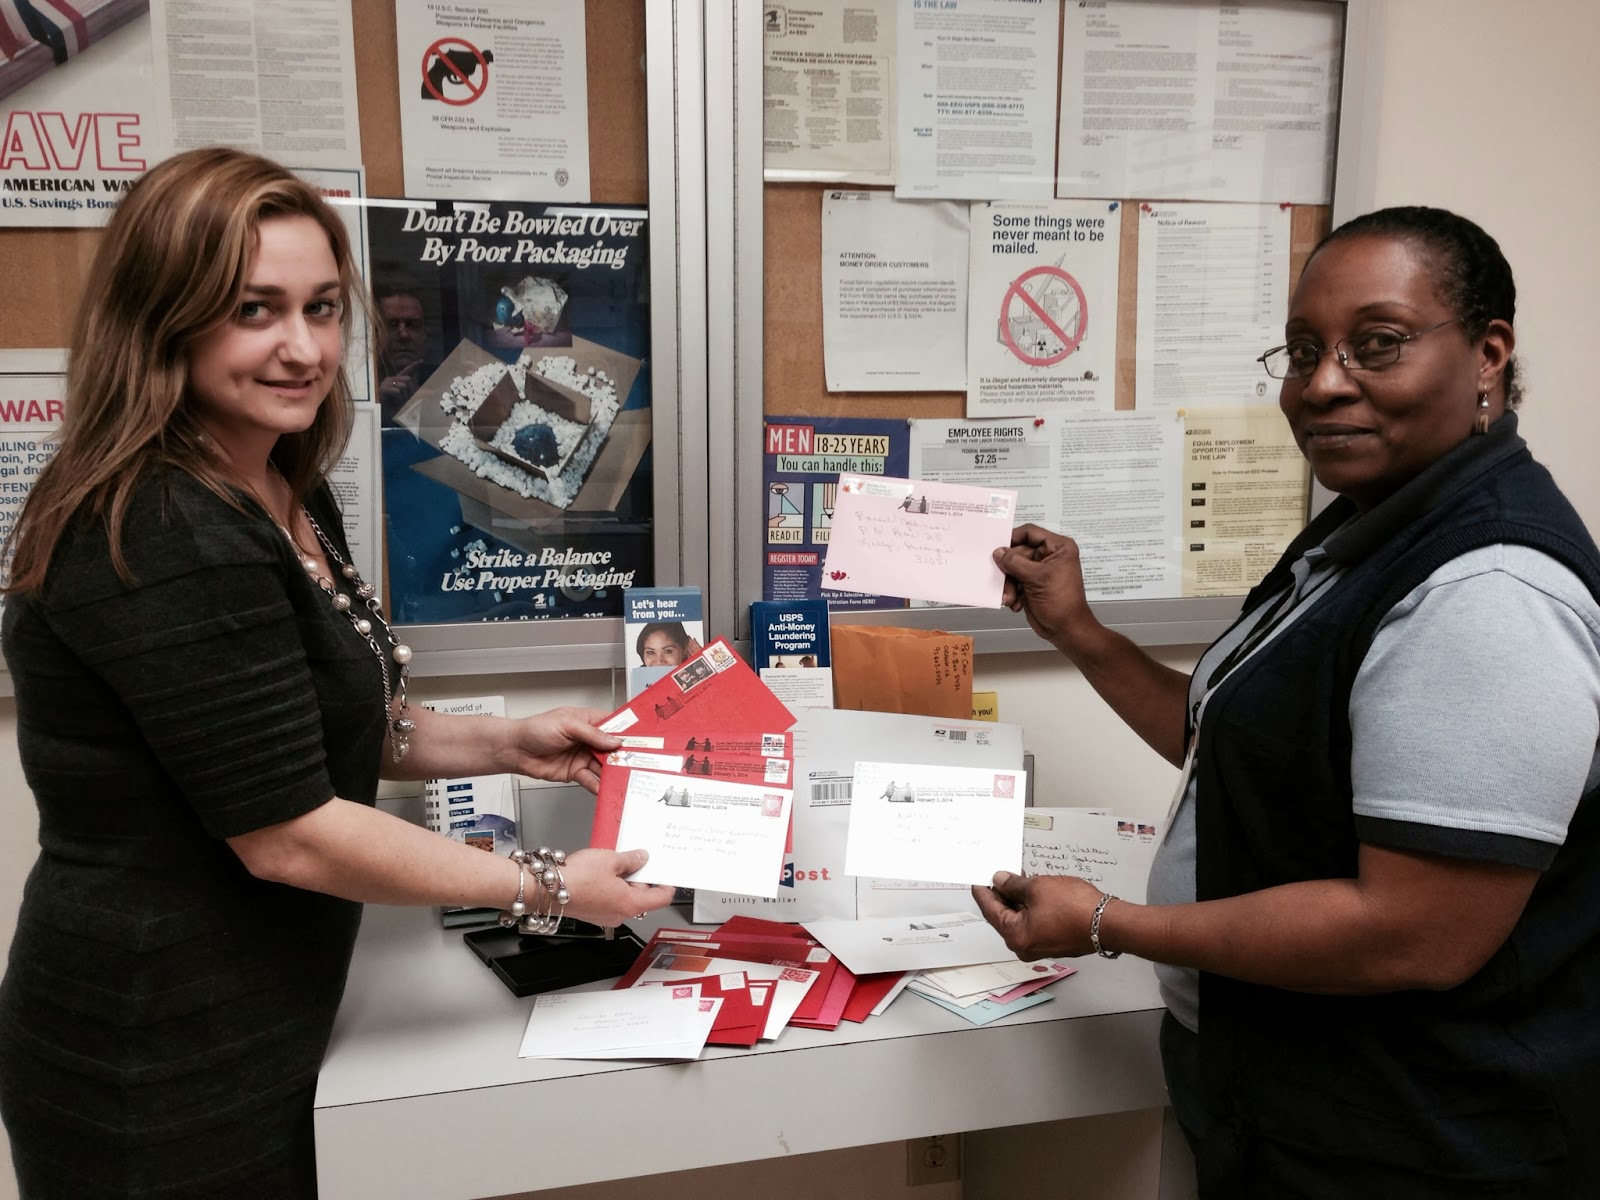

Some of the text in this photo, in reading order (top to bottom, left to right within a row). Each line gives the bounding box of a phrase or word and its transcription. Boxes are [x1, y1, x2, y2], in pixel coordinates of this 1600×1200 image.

[455, 6, 476, 14] Section
[923, 1, 938, 9] THE
[940, 2, 957, 10] LAW
[440, 124, 467, 132] Weapons
[3, 178, 95, 192] AMERICAN
[2, 198, 27, 209] U.S.
[29, 198, 82, 211] Savings
[402, 208, 643, 237] Don't Be Bowled Over
[993, 214, 1105, 230] Some things were
[993, 230, 1105, 242] never meant to be
[992, 242, 1038, 254] mailed.
[420, 238, 629, 270] By Poor Packaging
[889, 261, 930, 269] CUSTOMERS
[948, 427, 1023, 437] EMPLOYEE RIGHTS
[770, 428, 809, 453] MEN
[817, 437, 886, 455] 18-25 YEARS
[975, 454, 997, 464] $7.25
[781, 457, 882, 472] You can handle this:
[770, 530, 802, 541] READ IT.
[465, 548, 611, 569] Strike a Balance
[770, 554, 816, 563] REGISTER TODAY!
[441, 567, 635, 594] Use Proper Packaging
[632, 599, 678, 609] Let's hear
[632, 610, 685, 621] from you...
[779, 613, 804, 622] USPS
[768, 623, 815, 632] Anti-Money
[768, 632, 816, 642] Laundering
[775, 641, 811, 651] Program
[450, 704, 474, 713] world
[978, 708, 993, 716] you!
[721, 897, 756, 905] Utility
